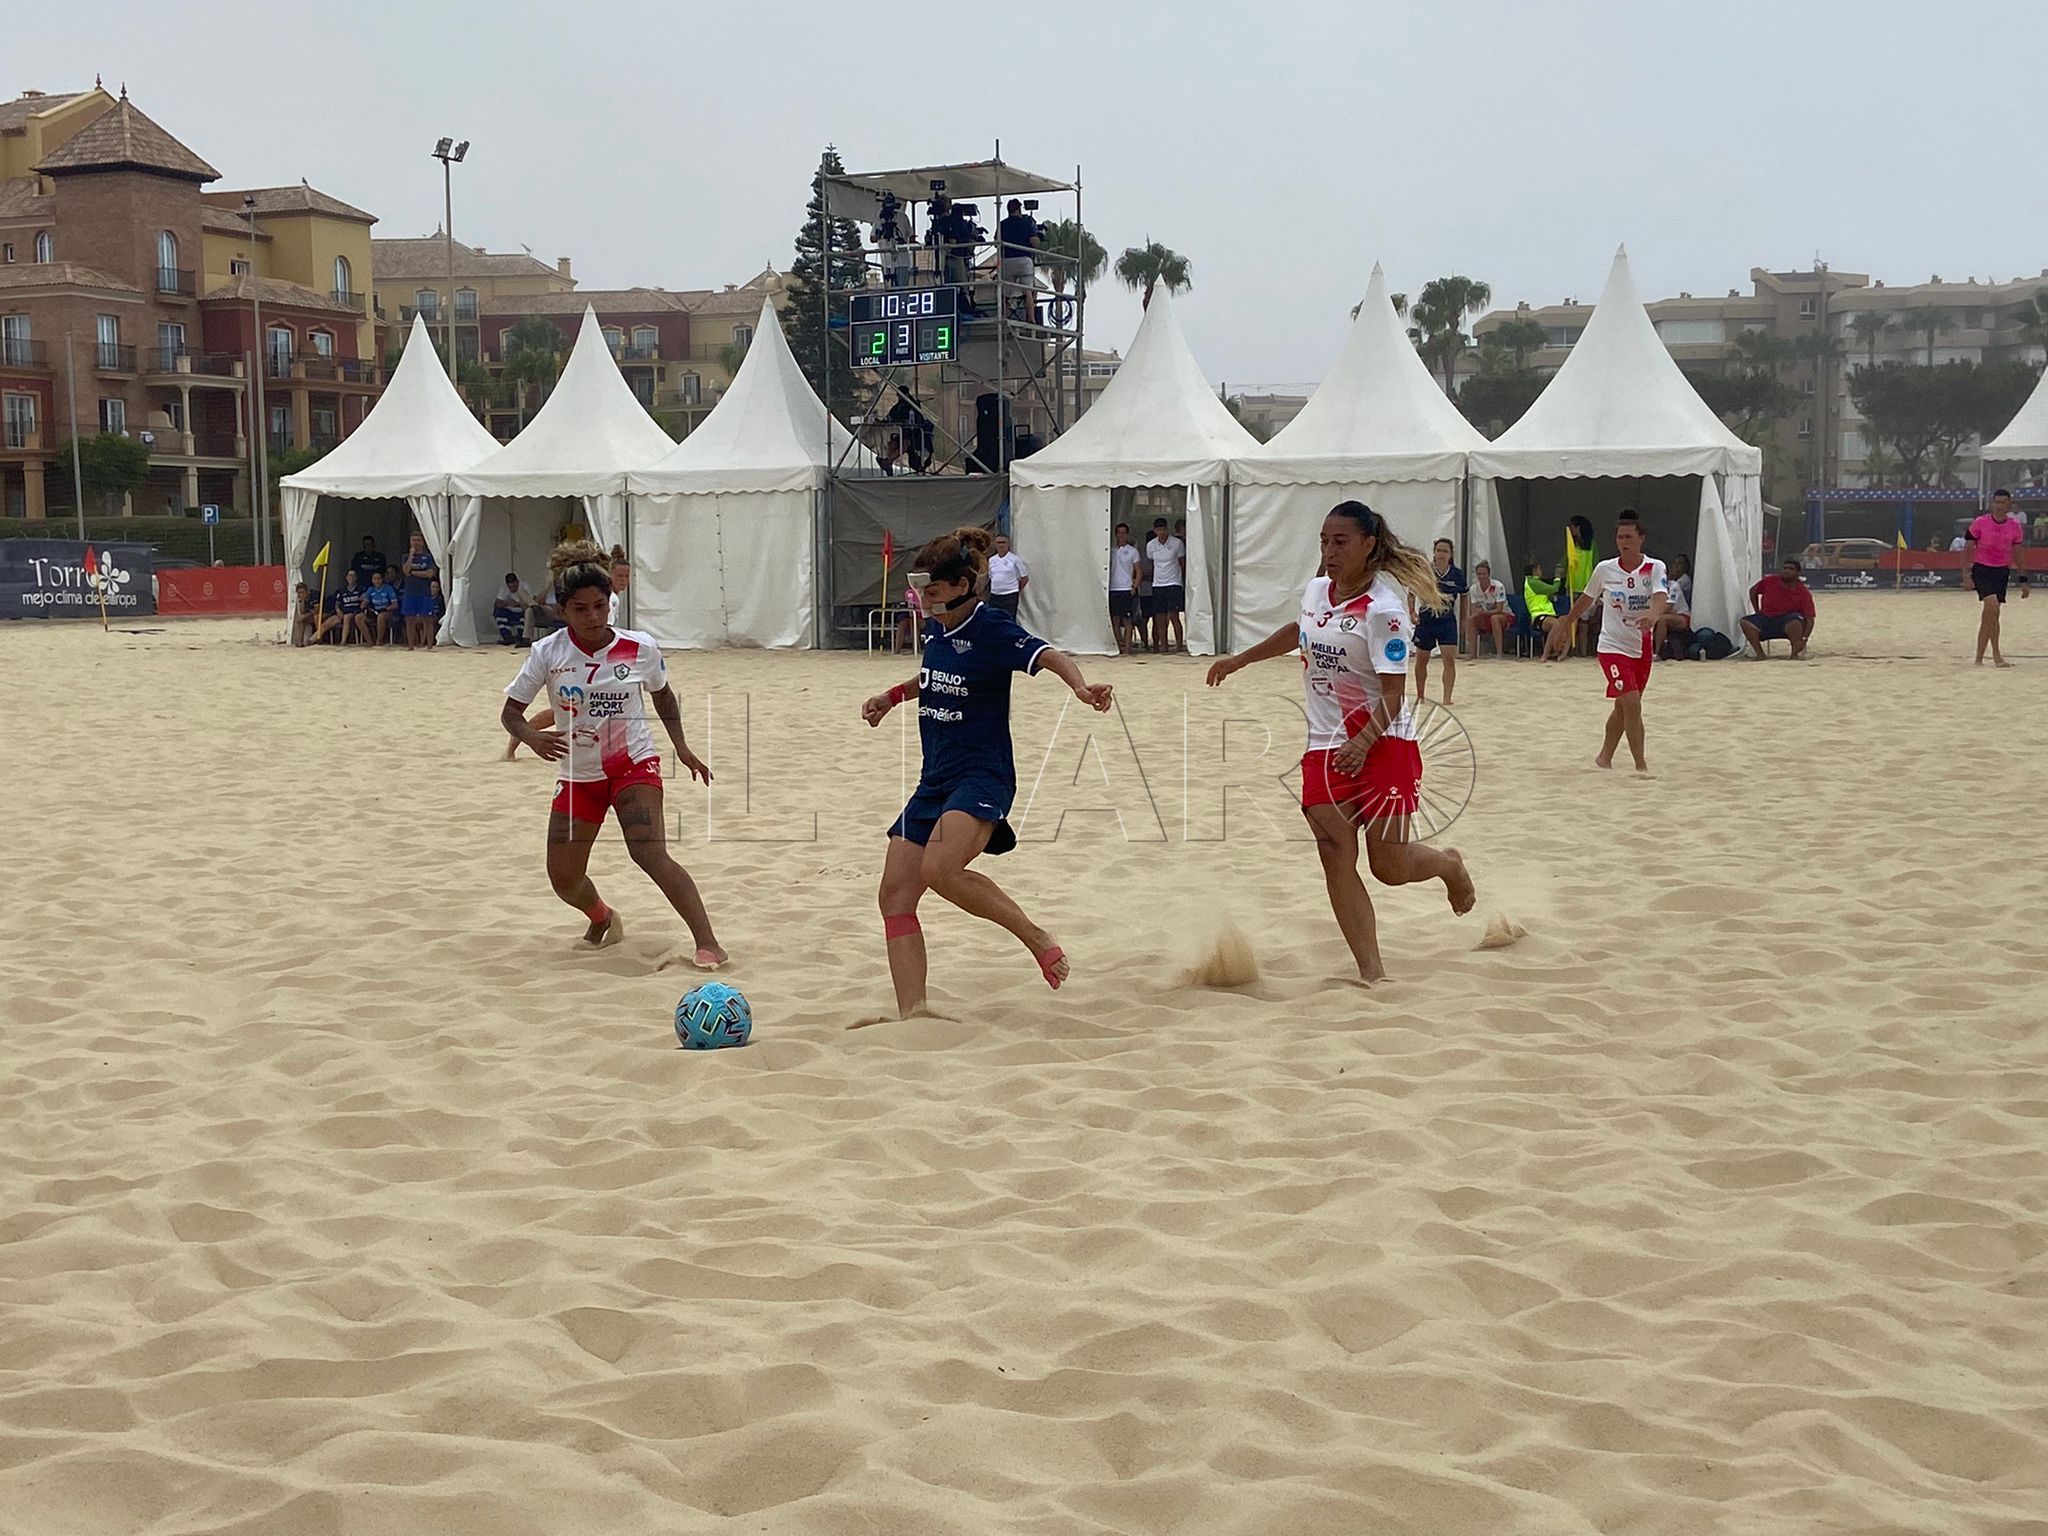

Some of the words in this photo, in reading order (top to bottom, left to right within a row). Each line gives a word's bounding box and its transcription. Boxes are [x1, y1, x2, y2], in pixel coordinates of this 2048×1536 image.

[881, 292, 934, 318] 10:28
[898, 324, 909, 346] 3
[937, 327, 949, 349] 3
[872, 332, 885, 354] 2
[860, 356, 880, 366] LOCAL
[919, 351, 949, 361] VISITANTE
[205, 507, 214, 522] P
[1627, 577, 1635, 589] 8
[55, 590, 82, 604] clima
[85, 591, 100, 605] de
[1317, 611, 1333, 628] 3
[585, 662, 601, 685] 7
[932, 670, 962, 685] BENJO
[1610, 664, 1620, 679] 8
[931, 681, 969, 697] SPORTS
[589, 700, 624, 709] SPORT
